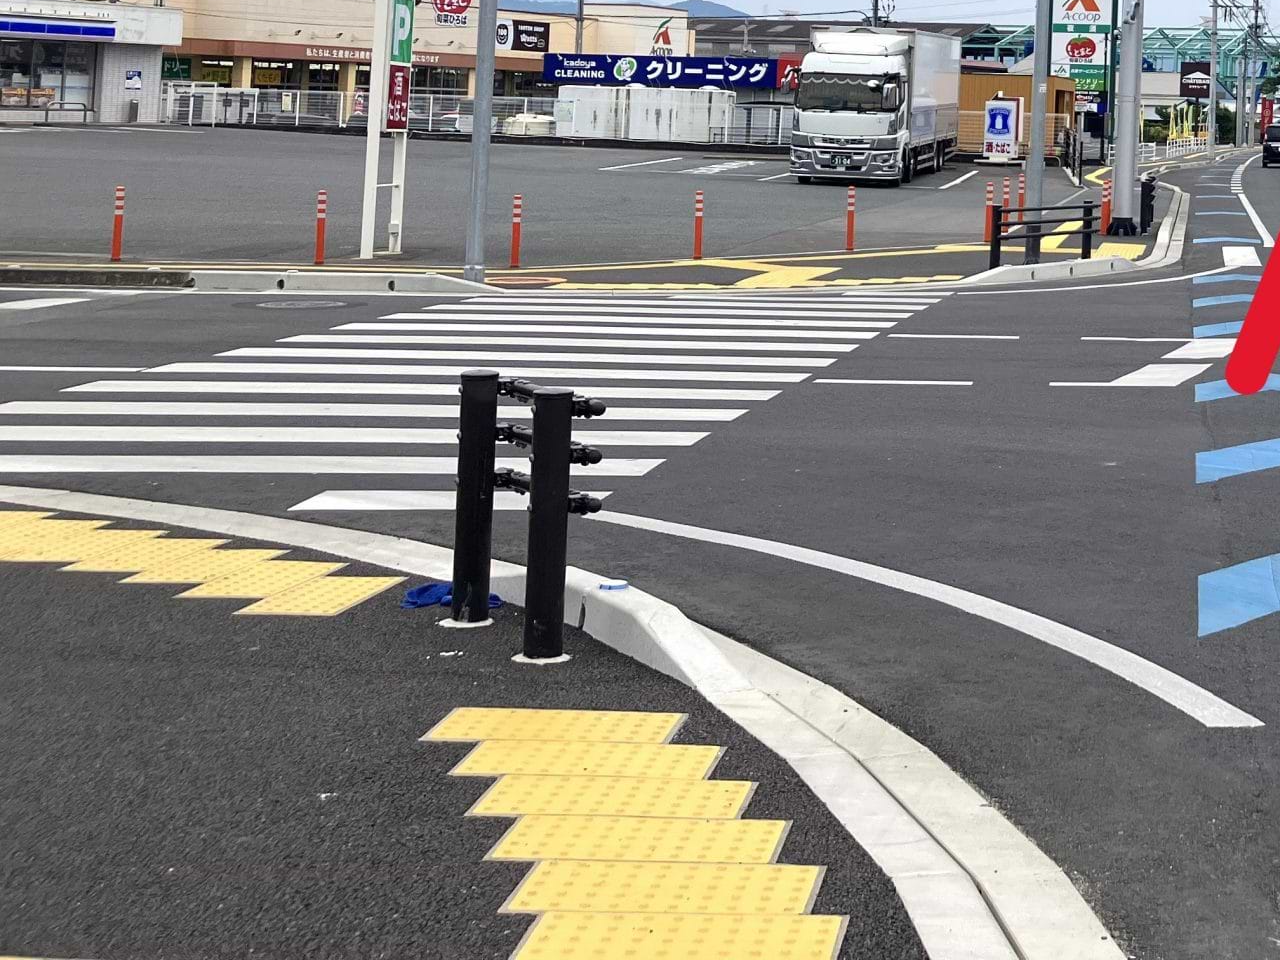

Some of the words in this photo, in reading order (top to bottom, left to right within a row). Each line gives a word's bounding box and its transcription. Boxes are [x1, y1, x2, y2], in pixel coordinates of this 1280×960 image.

[394, 3, 411, 56] P
[563, 58, 597, 67] kadoya
[554, 69, 605, 79] CLEANING
[646, 61, 769, 82] クリーニング
